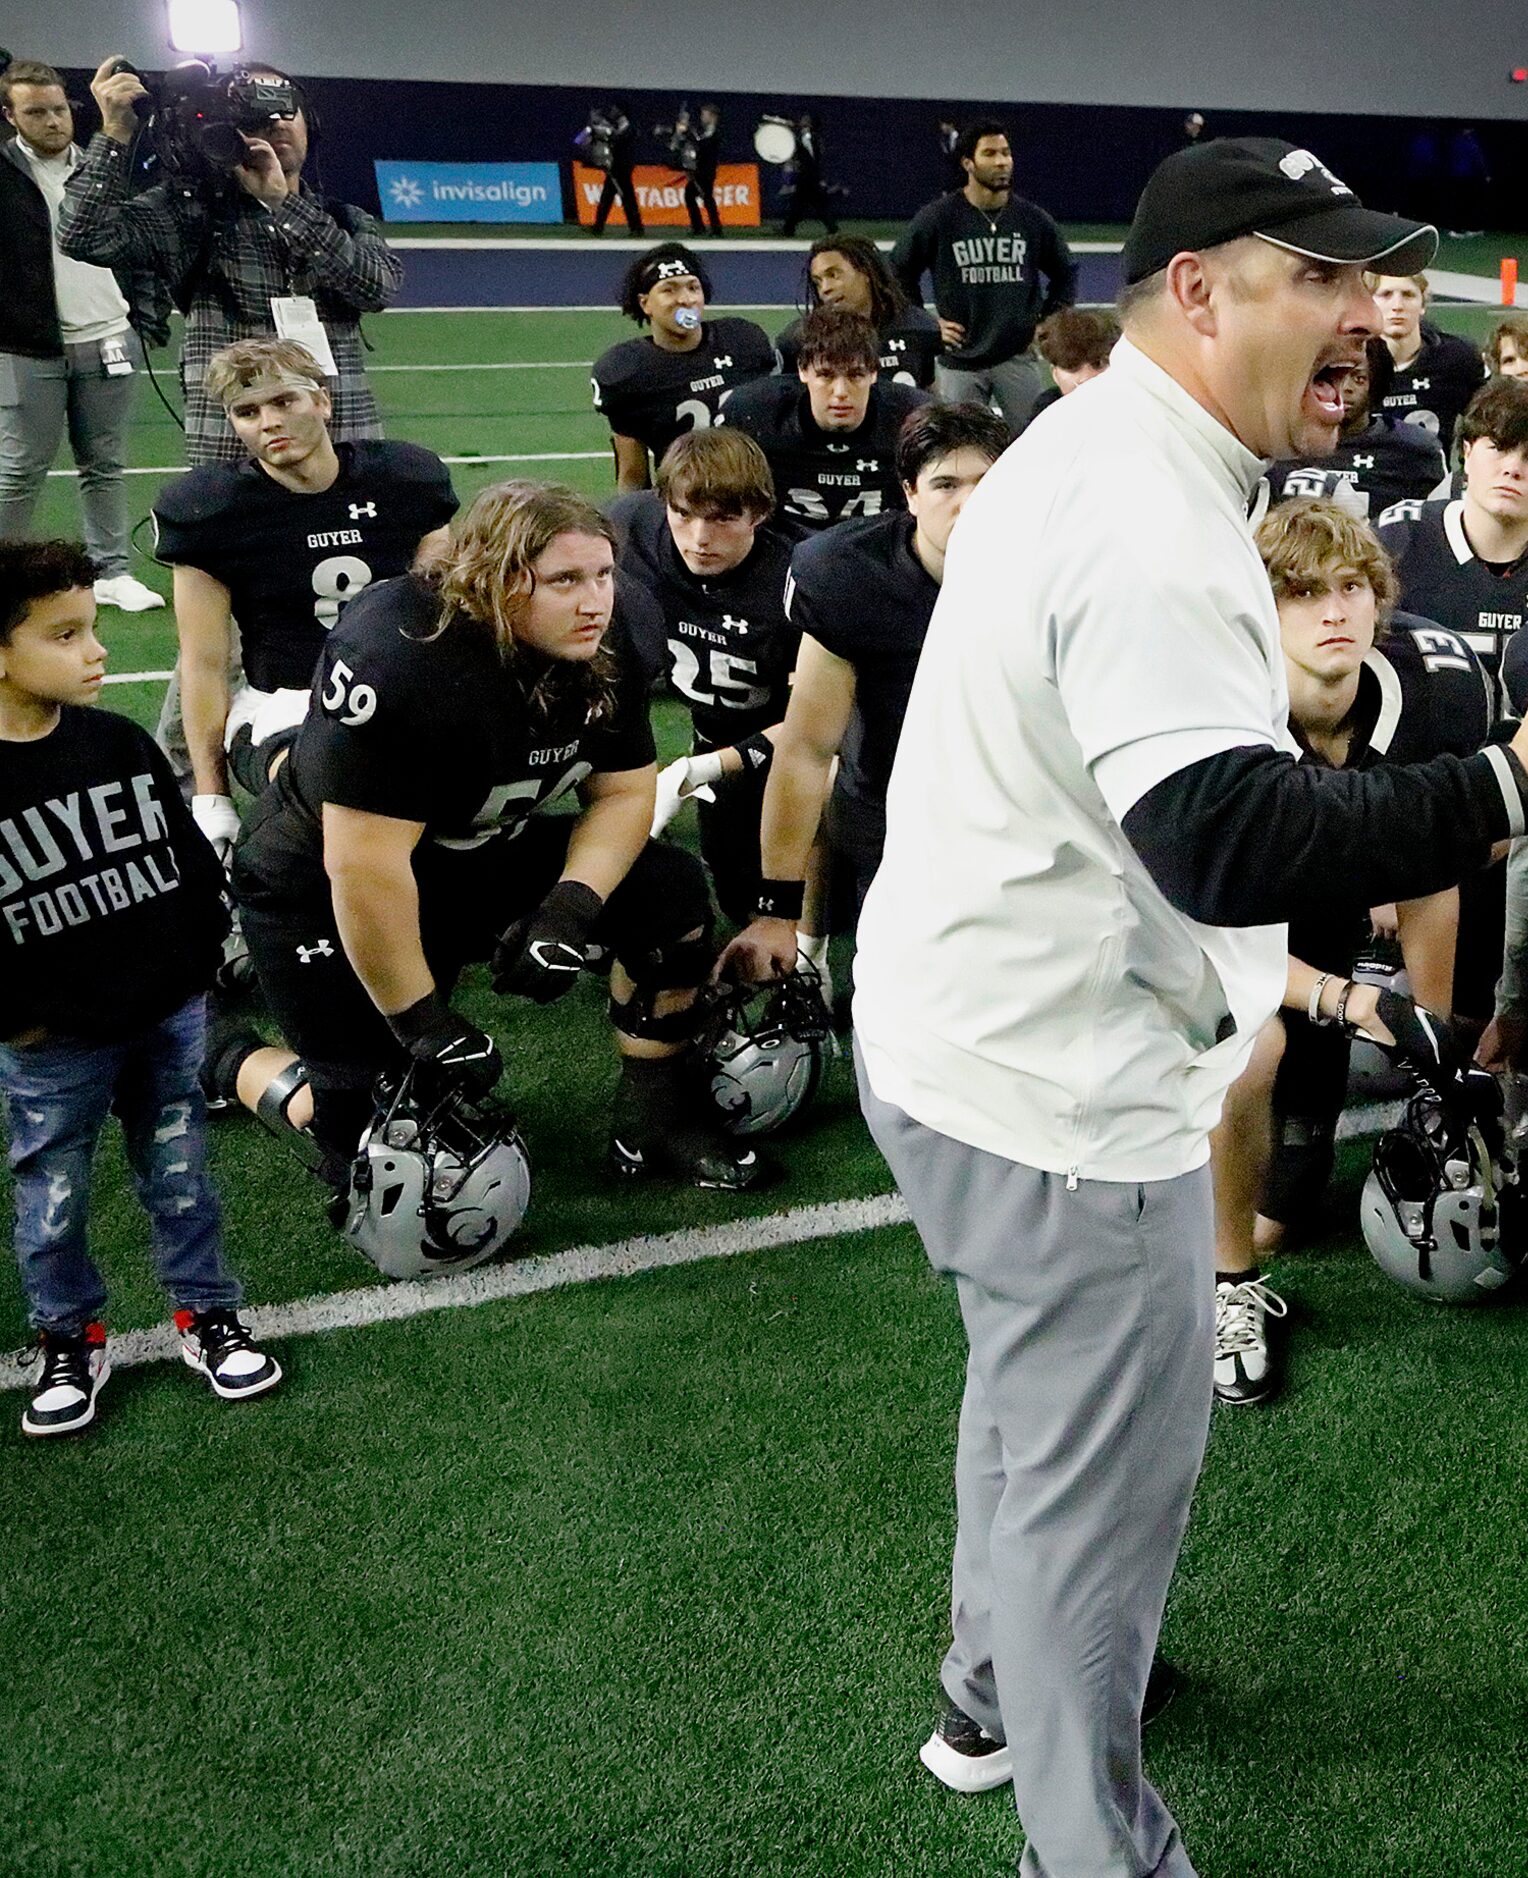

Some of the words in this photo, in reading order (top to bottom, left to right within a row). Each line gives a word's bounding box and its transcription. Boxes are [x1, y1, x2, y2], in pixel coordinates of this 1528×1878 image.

[432, 180, 546, 207] invisalign
[952, 236, 1027, 267] GUYER
[961, 265, 1024, 284] FOOTBALL
[690, 373, 725, 393] GUYER
[1383, 394, 1418, 408] GUYER
[817, 473, 861, 486] GUYER
[307, 529, 364, 549] GUYER
[1478, 611, 1522, 630] GUYER
[678, 621, 727, 646] GUYER
[1410, 628, 1472, 673] 13
[666, 638, 771, 710] 25
[322, 658, 377, 726] 59
[528, 739, 580, 766] GUYER
